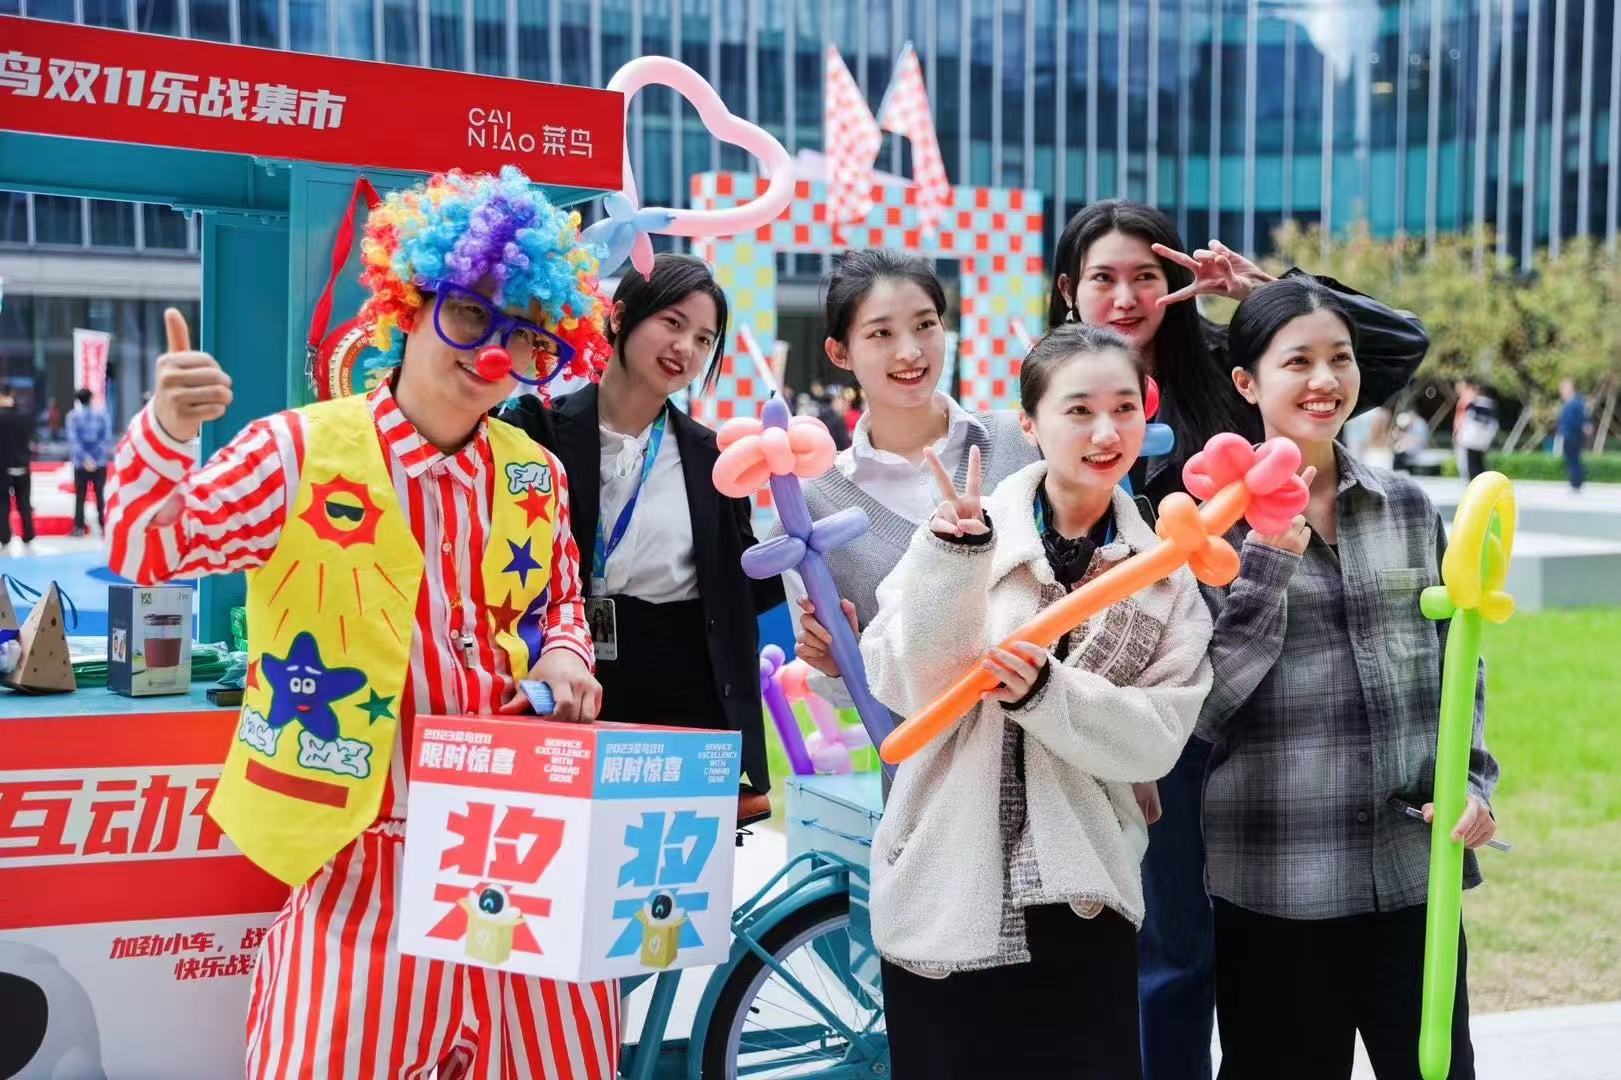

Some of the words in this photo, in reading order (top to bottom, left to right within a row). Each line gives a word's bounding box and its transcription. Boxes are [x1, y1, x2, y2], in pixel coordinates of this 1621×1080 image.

[0, 50, 347, 130] 鸟双11乐战集市
[468, 107, 511, 130] CAI
[543, 124, 593, 159] 菜鸟
[418, 741, 517, 776] 限时惊喜
[535, 746, 592, 759] EXCELLENCE
[544, 738, 583, 749] SERVICE
[551, 755, 574, 766] WITH
[601, 754, 684, 785] 限时惊喜
[425, 801, 567, 955] 奖
[605, 810, 720, 959] 奖
[174, 954, 256, 981] 快乐战
